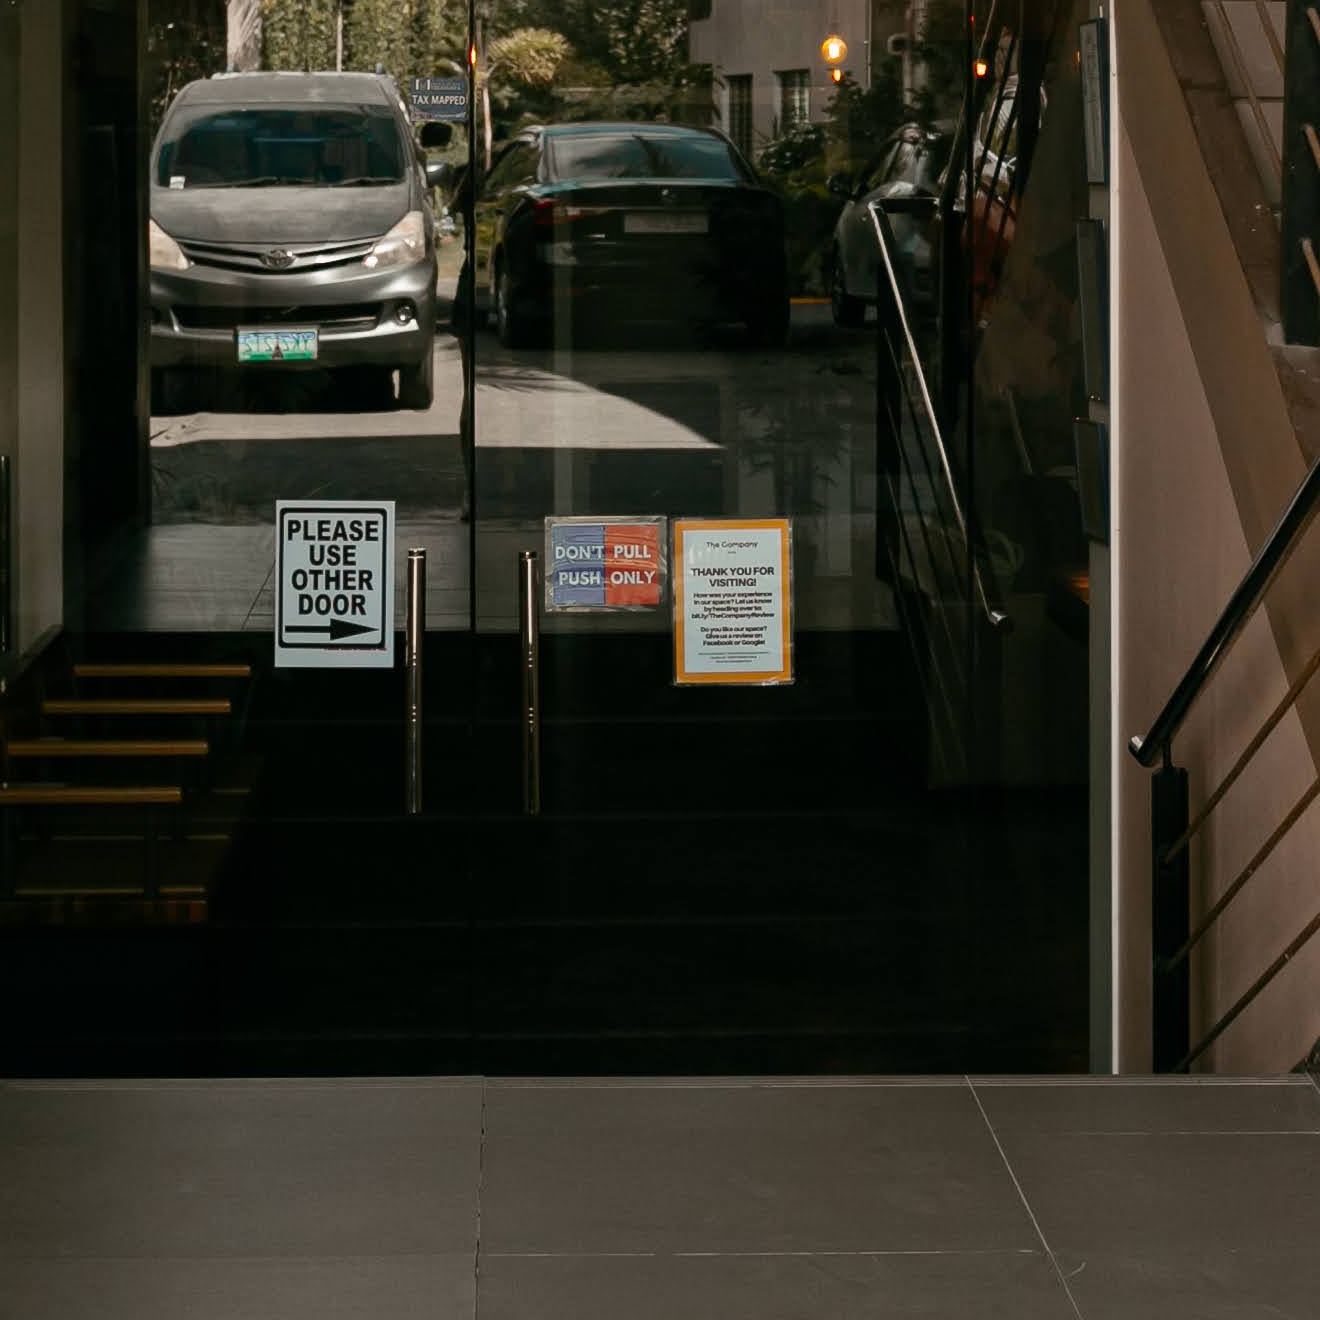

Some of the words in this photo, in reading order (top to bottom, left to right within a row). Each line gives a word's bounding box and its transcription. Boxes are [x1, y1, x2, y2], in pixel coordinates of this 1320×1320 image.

[411, 95, 429, 104] TAX
[431, 95, 466, 105] MAPPED
[287, 520, 379, 541] PLEASE
[555, 545, 604, 559] DON'T
[614, 544, 651, 559] PULL
[706, 541, 720, 549] The
[721, 541, 758, 549] Company
[309, 545, 356, 566] USE
[558, 571, 601, 585] PUSH
[610, 570, 656, 585] ONLY
[691, 568, 728, 576] THANK
[730, 567, 752, 576] YOU
[753, 566, 775, 575] FOR
[291, 569, 374, 591] OTHER
[709, 578, 757, 587] VISITING!
[298, 594, 367, 616] DOOR
